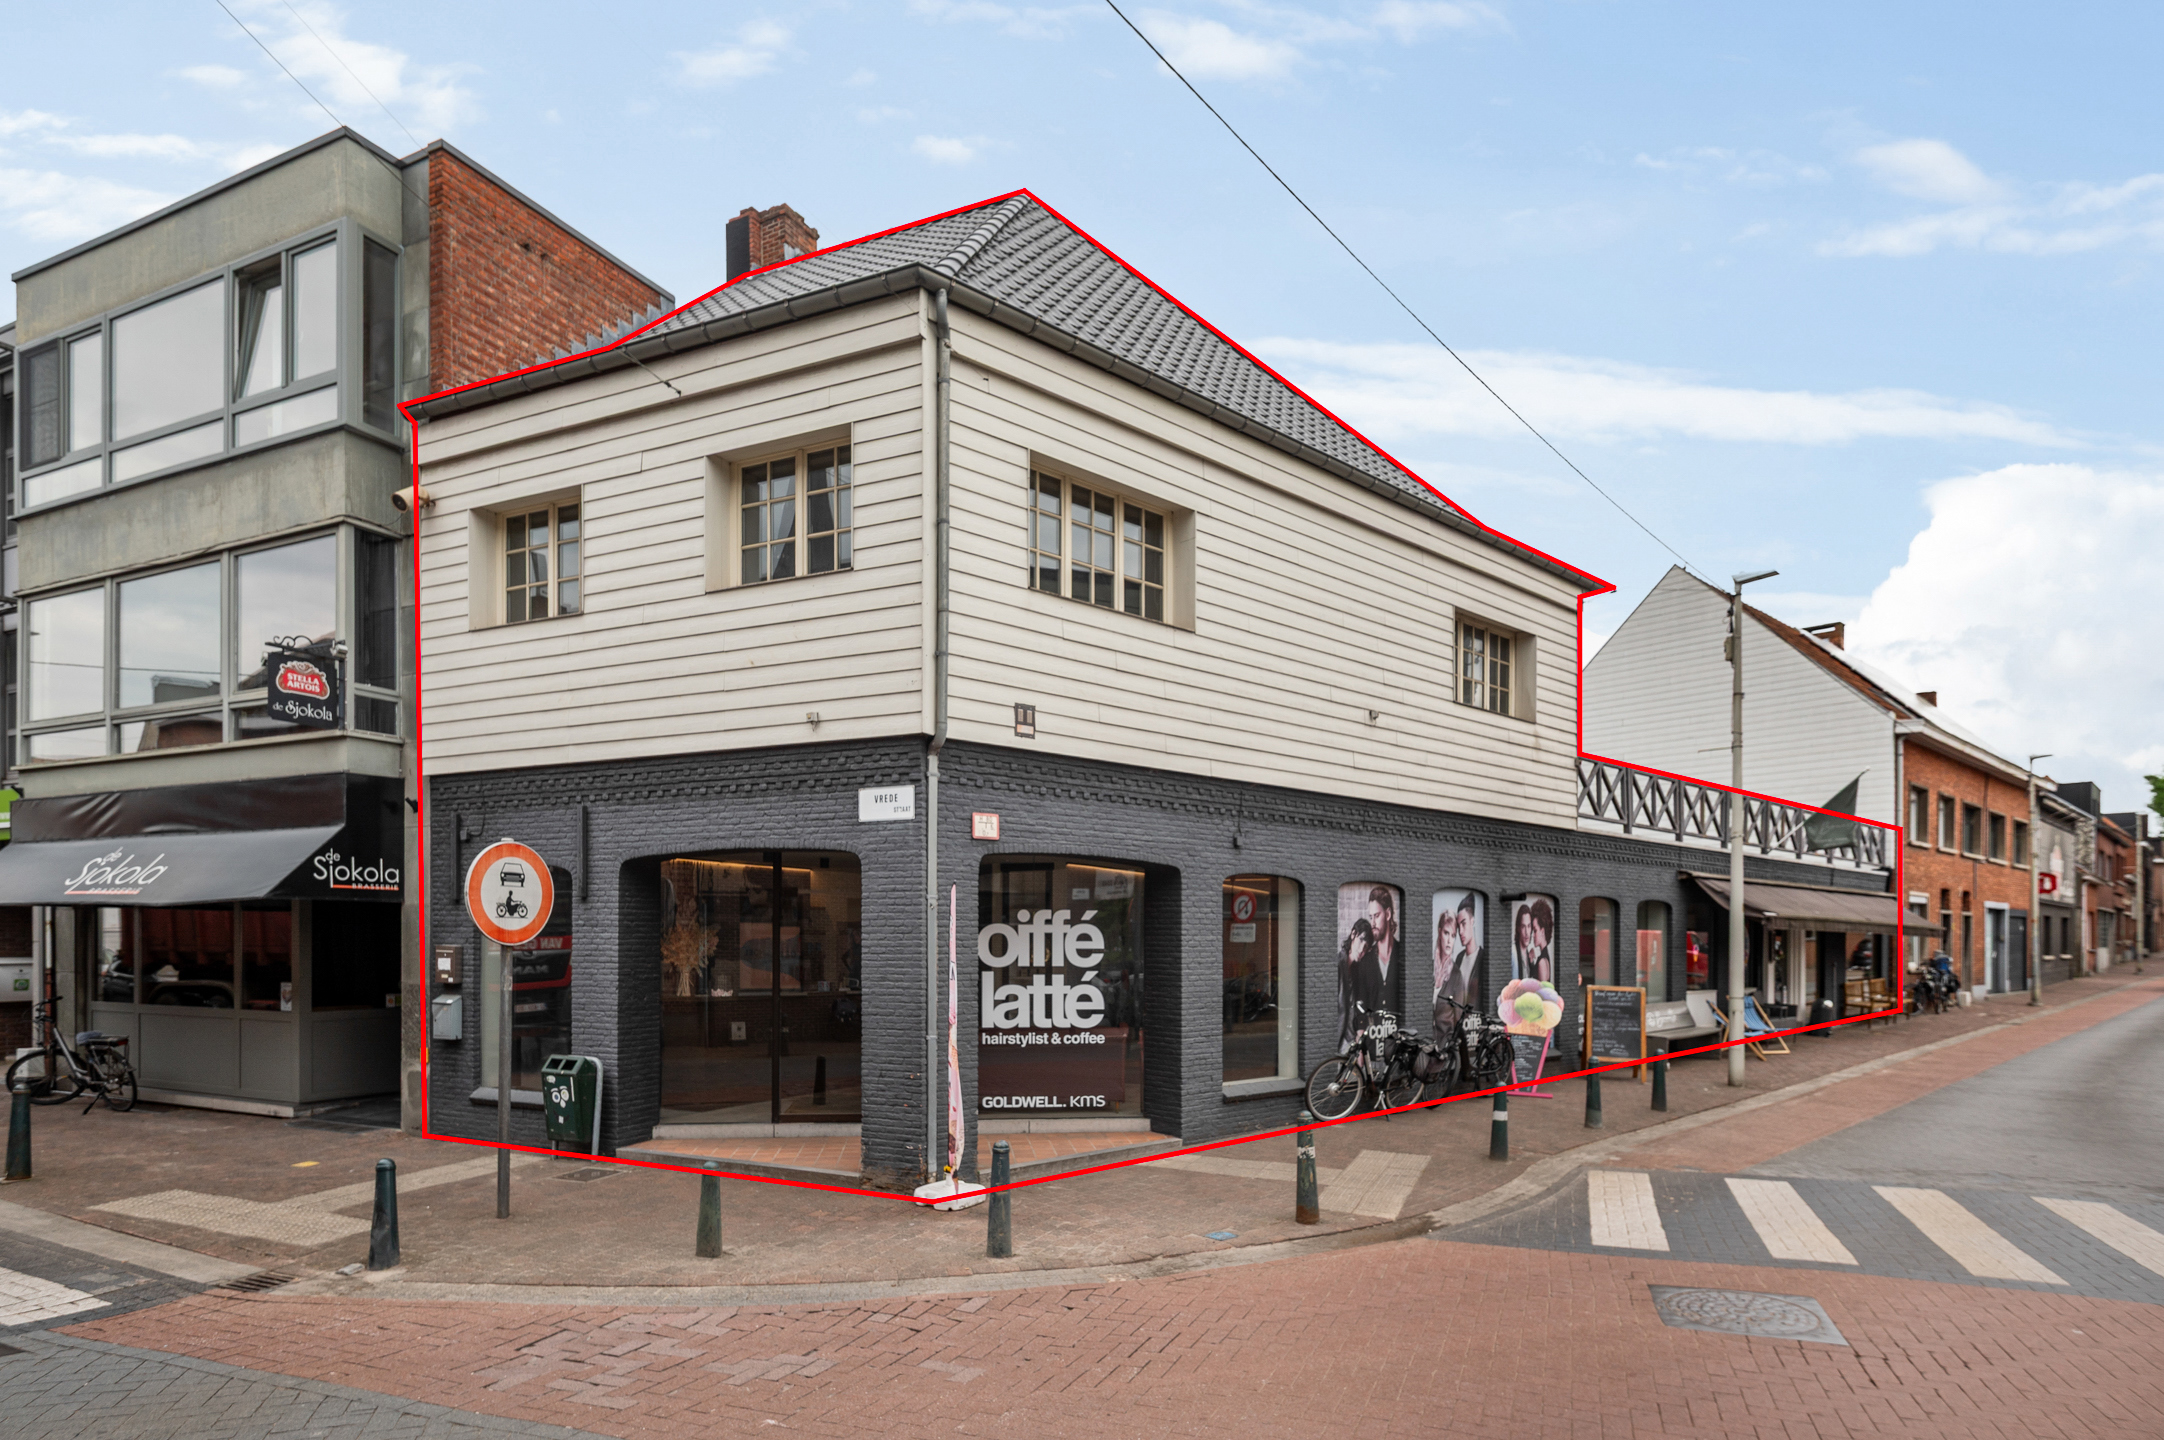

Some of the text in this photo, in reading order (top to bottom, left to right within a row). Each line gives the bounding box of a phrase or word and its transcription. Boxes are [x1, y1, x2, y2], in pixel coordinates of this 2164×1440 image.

[286, 672, 320, 686] STELLA
[286, 680, 321, 693] ARTOIS
[272, 699, 333, 721] de Sjokola
[874, 793, 899, 803] VREDE
[101, 846, 124, 862] de
[325, 847, 341, 861] de
[64, 852, 169, 895] Sjokola
[313, 855, 400, 889] Sjokola
[351, 882, 399, 891] BRASSERIE
[978, 909, 1105, 968] oiffé
[981, 971, 1105, 1029] latté
[1462, 1013, 1482, 1031] oiffé
[982, 1032, 1106, 1047] hairstylist & coffee
